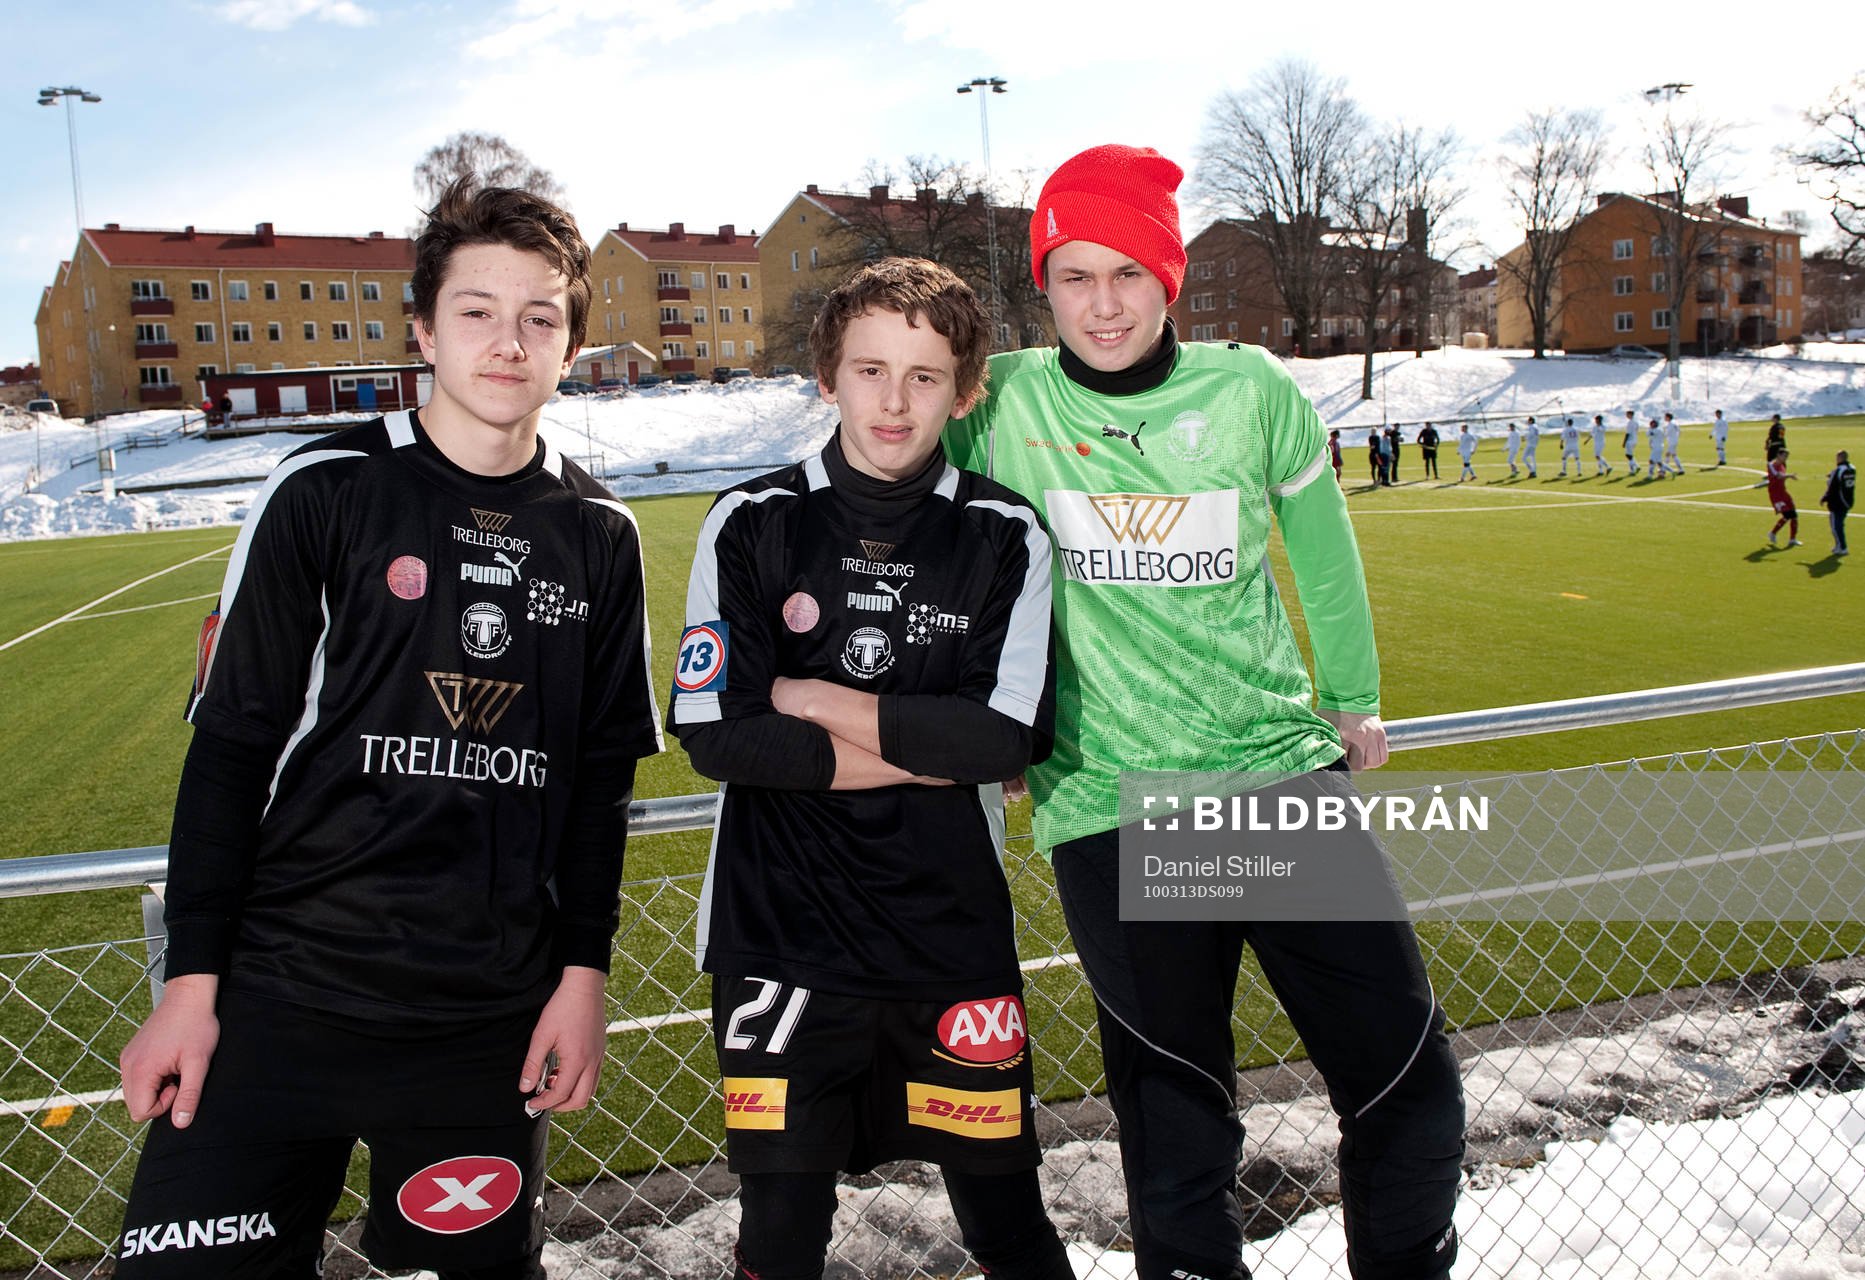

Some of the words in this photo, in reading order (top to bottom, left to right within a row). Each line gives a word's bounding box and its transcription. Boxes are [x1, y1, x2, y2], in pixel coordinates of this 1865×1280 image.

[451, 525, 531, 554] TRELLEBORG
[460, 562, 513, 586] PUMA
[841, 557, 915, 577] TRELLEBORG
[1059, 548, 1234, 583] TRELLEBORG
[847, 591, 893, 612] PUMA
[679, 641, 714, 674] 13
[360, 734, 548, 788] TRELLEBORG
[724, 977, 811, 1054] 21
[948, 1000, 1026, 1047] AXA
[724, 1092, 768, 1113] HL
[922, 1097, 1007, 1124] DHL
[120, 1212, 276, 1259] SKANSKA
